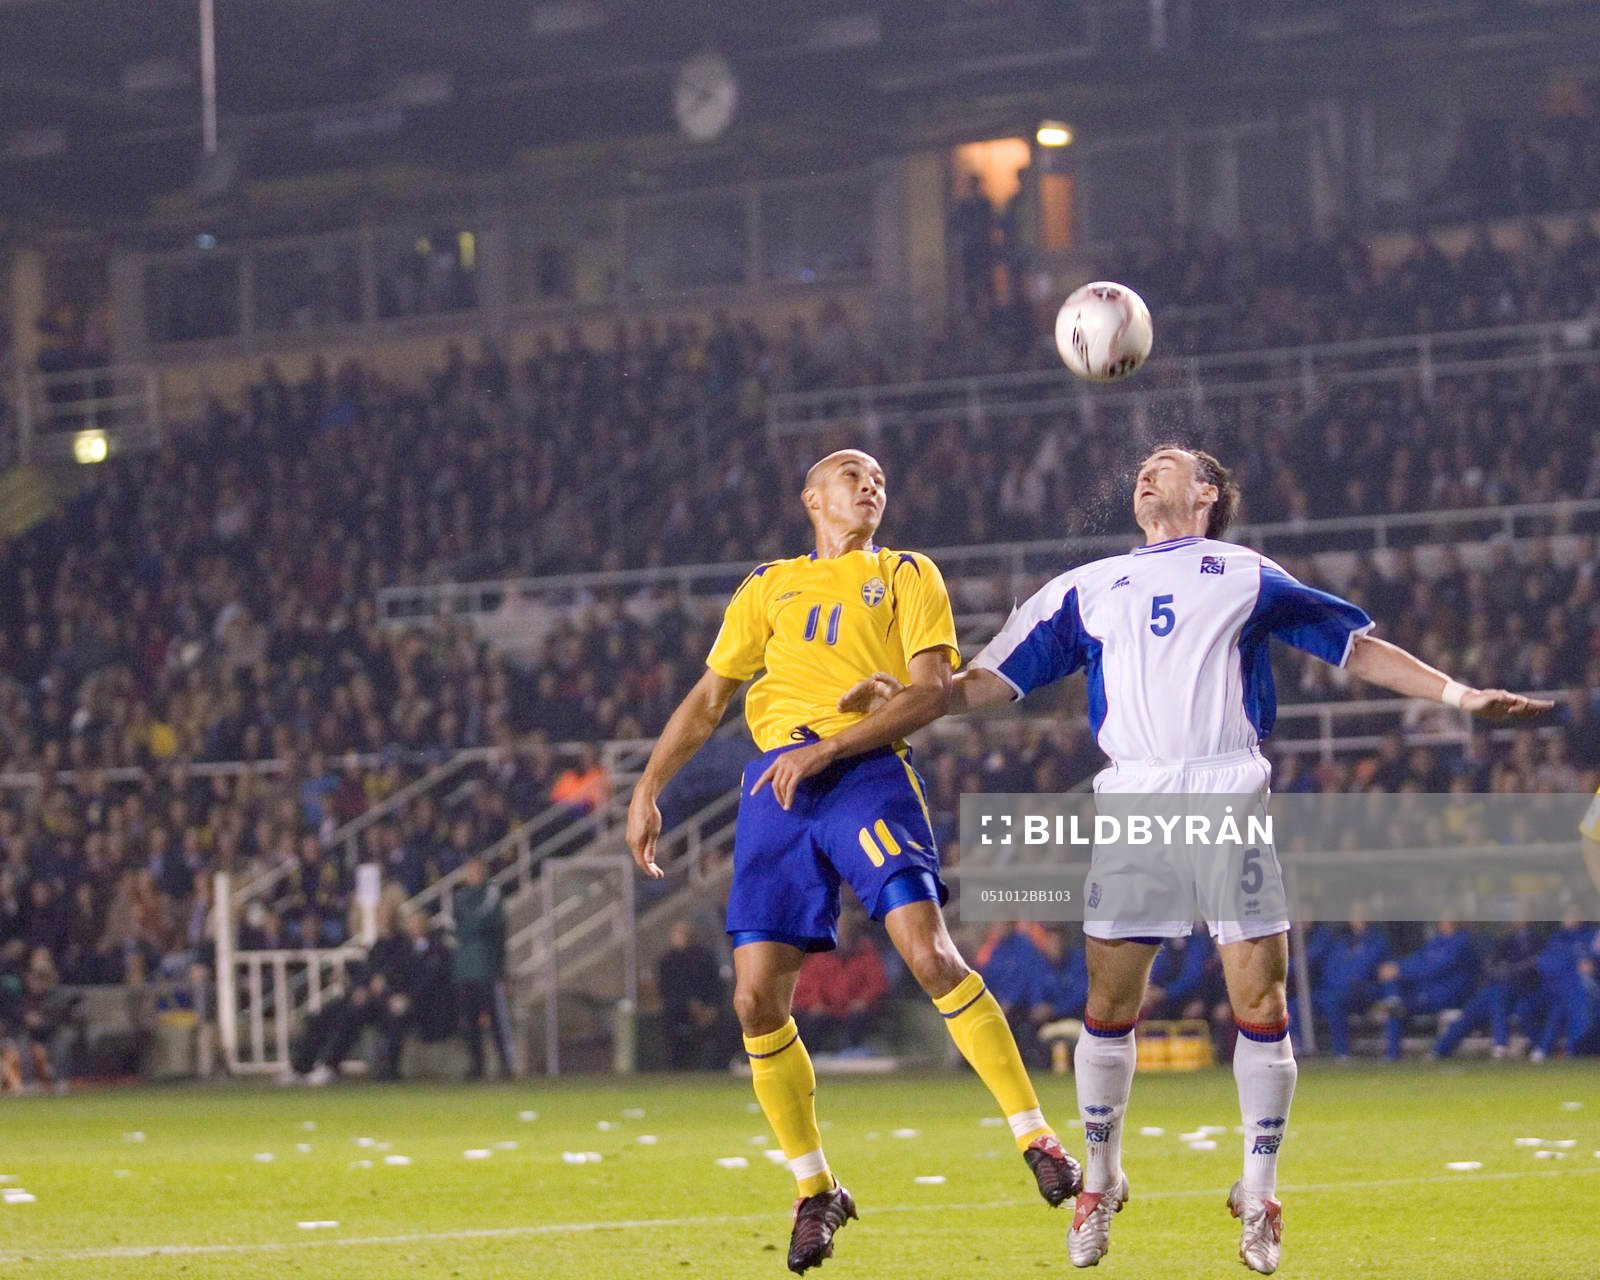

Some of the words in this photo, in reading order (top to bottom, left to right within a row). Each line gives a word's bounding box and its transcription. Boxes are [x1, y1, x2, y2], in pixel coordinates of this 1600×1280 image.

[803, 603, 842, 646] 11
[1150, 594, 1176, 637] 5
[858, 818, 902, 868] 11
[1241, 847, 1264, 895] 5
